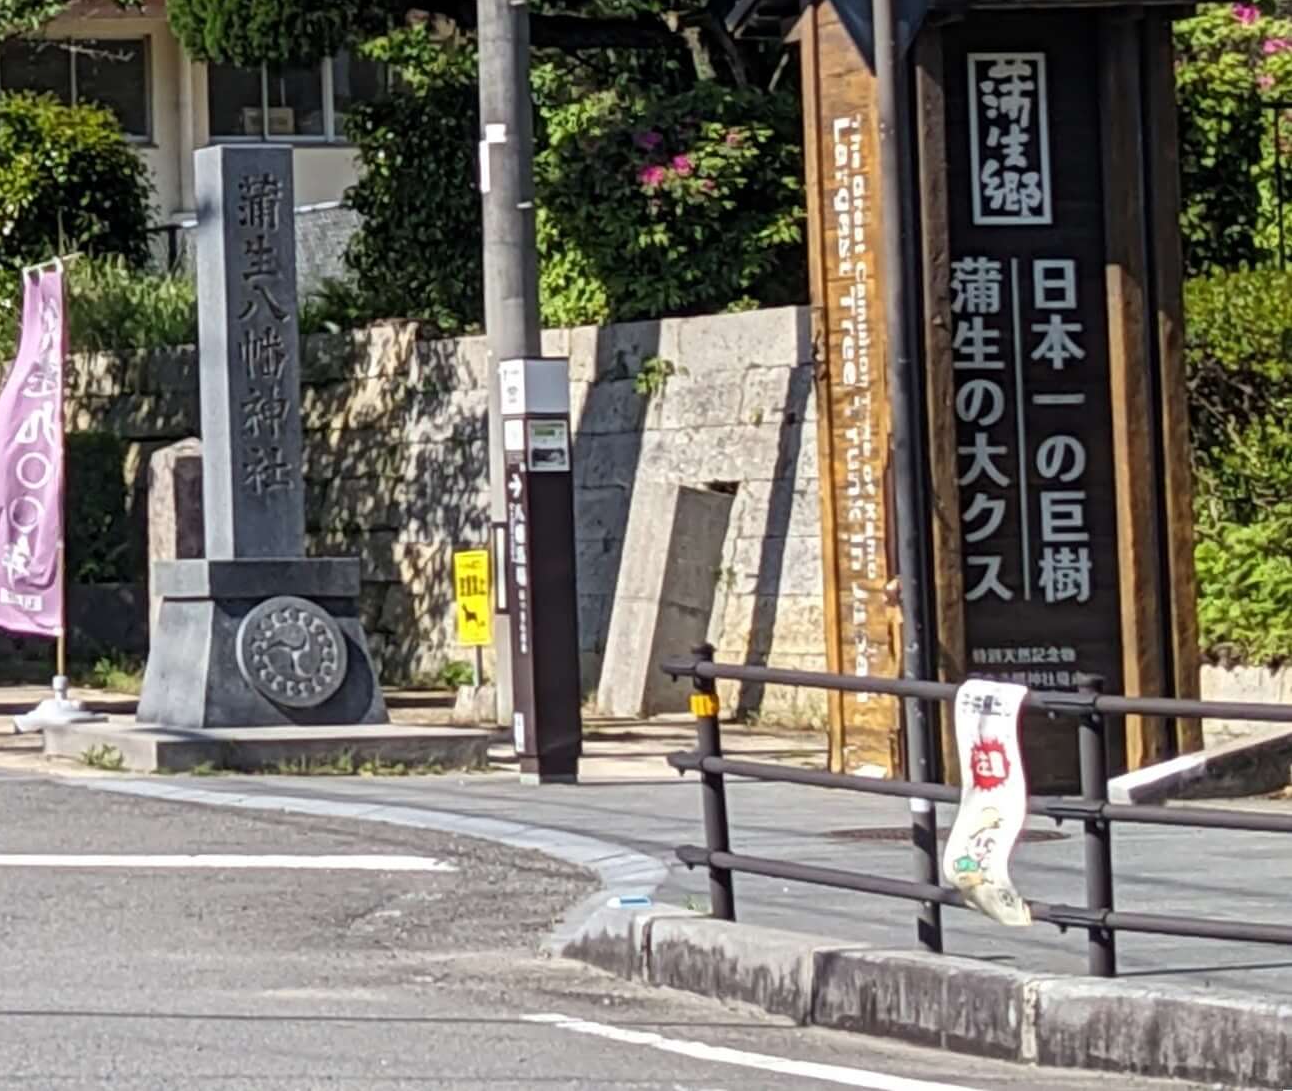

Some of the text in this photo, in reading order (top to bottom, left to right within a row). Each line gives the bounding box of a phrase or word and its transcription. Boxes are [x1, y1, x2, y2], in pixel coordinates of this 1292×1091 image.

[980, 59, 1043, 217] 蒲生郷
[239, 172, 295, 495] 蒲生八幡神社
[839, 285, 856, 386] Tree
[951, 257, 1013, 600] 蒲生の大クス
[1030, 259, 1092, 602] 日本一の巨樹
